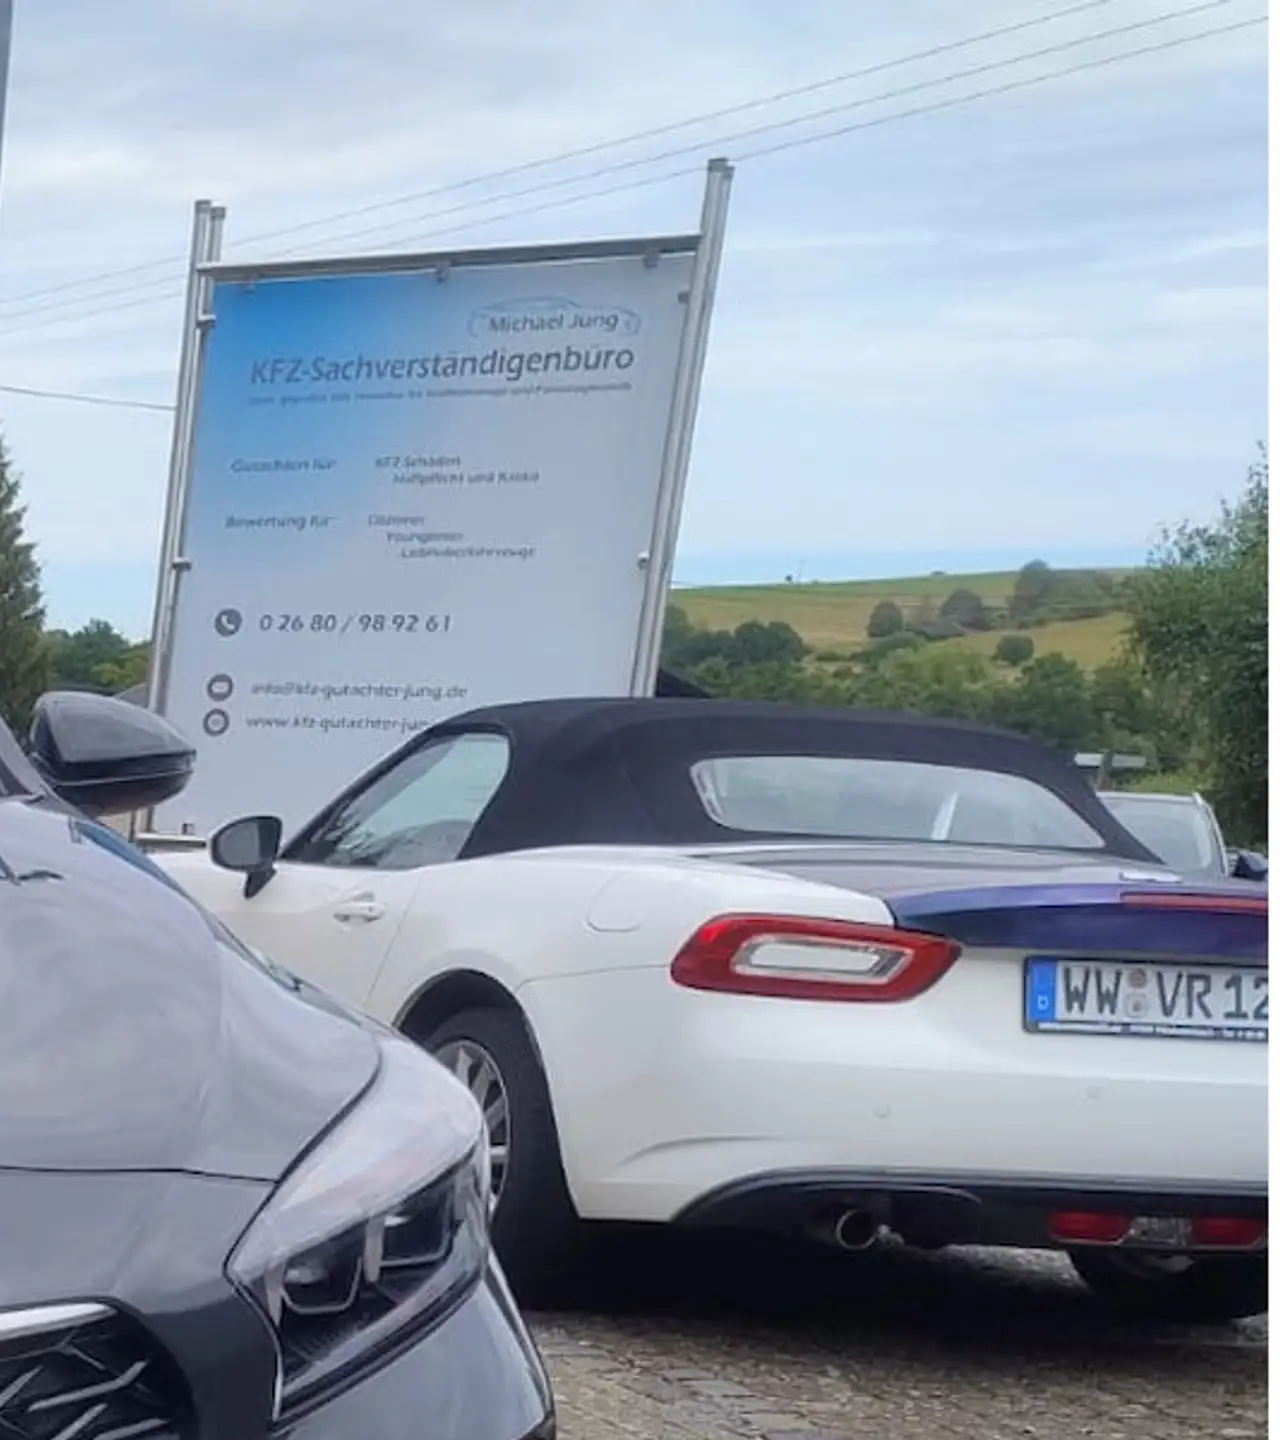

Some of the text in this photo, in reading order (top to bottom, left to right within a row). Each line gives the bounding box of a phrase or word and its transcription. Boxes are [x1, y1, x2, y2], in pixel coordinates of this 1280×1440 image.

[488, 311, 621, 334] Michael Jung
[250, 345, 635, 386] KFZ-Sachverständigenbüro
[259, 614, 273, 633] 0
[276, 614, 304, 633] 26
[310, 614, 337, 633] 80
[358, 614, 386, 633] 98
[392, 614, 419, 633] 92
[1063, 966, 1122, 1015] WW
[1156, 969, 1212, 1018] VR
